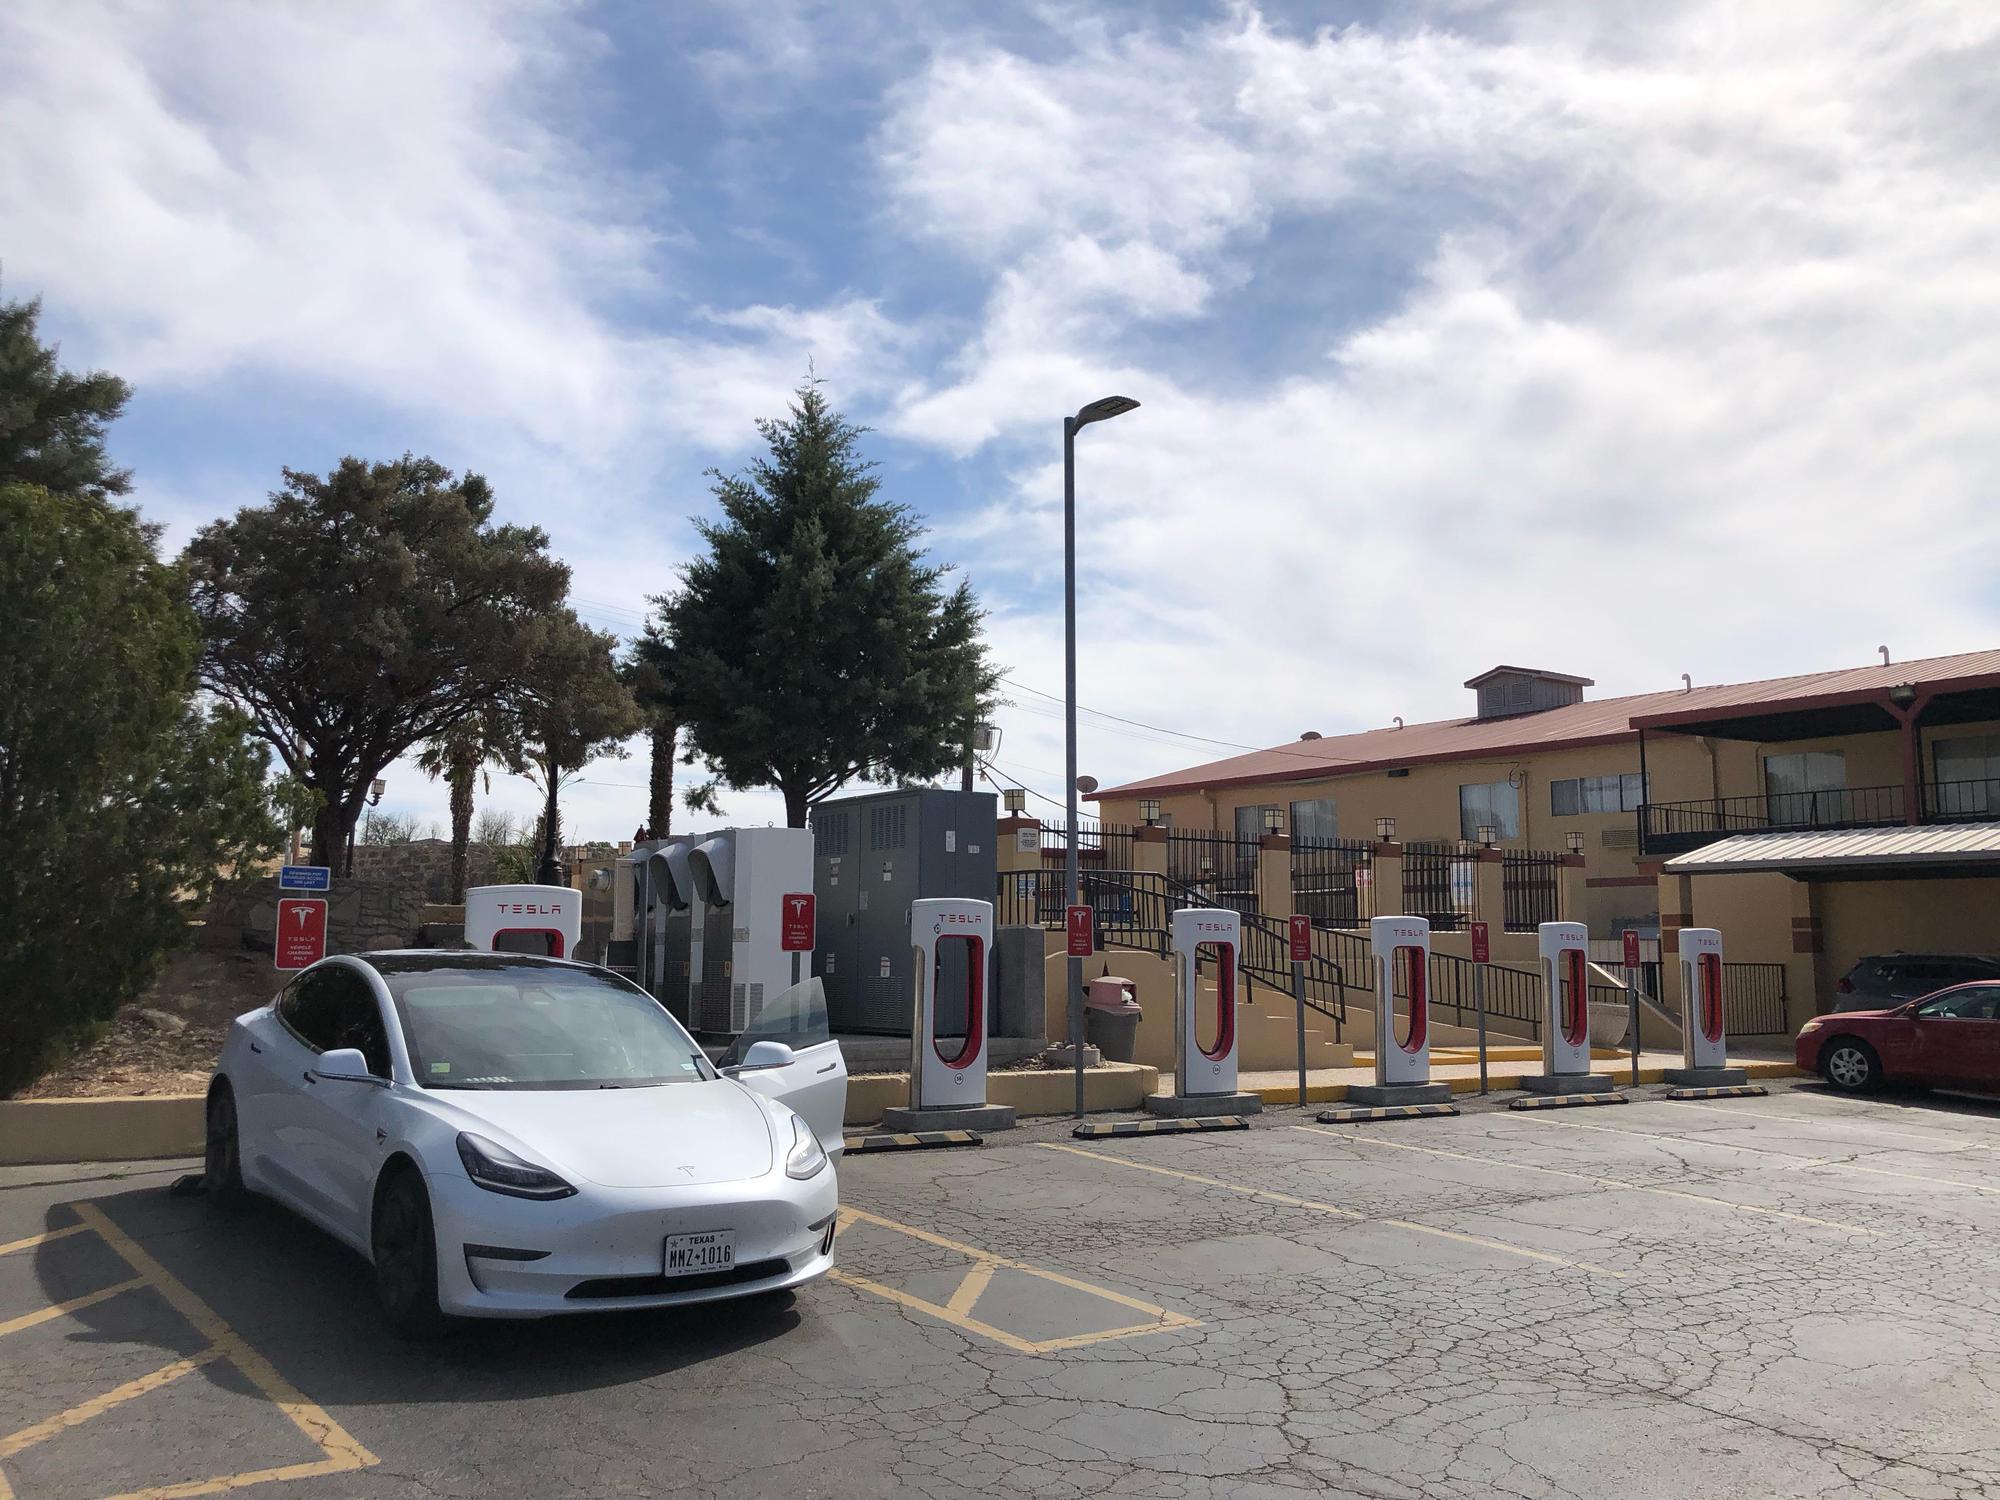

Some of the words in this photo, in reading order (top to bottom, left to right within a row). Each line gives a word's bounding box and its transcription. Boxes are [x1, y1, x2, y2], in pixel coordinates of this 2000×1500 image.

[497, 904, 561, 914] TESLA
[939, 914, 982, 923] TESLA
[1197, 923, 1233, 932] TESLA
[1393, 929, 1424, 937] TESLA
[689, 1235, 715, 1244] TEXAS
